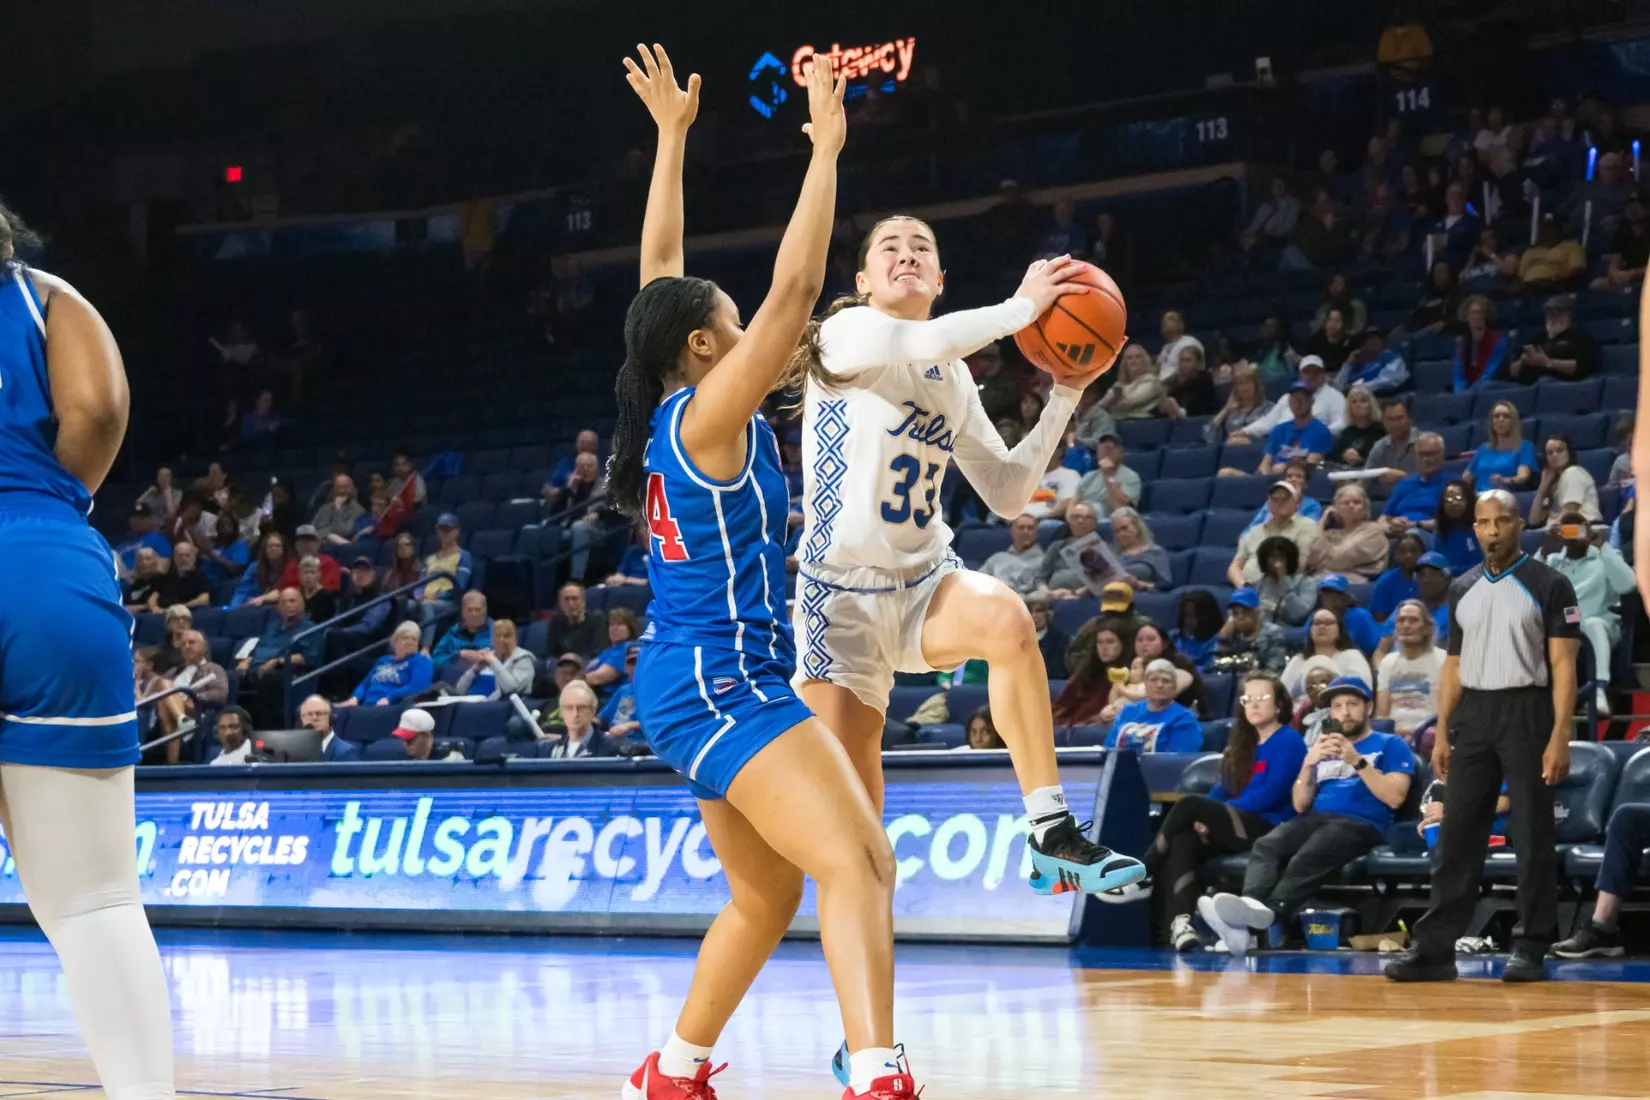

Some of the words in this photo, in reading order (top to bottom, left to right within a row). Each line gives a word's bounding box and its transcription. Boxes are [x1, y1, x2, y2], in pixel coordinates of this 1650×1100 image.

[791, 37, 915, 87] Gteway
[1396, 87, 1430, 112] 114
[1196, 117, 1229, 141] 113
[566, 210, 592, 232] 113
[887, 400, 957, 452] Tuls
[191, 801, 270, 830] TULSA
[178, 835, 310, 865] RECYCLES
[164, 868, 231, 897] .COM
